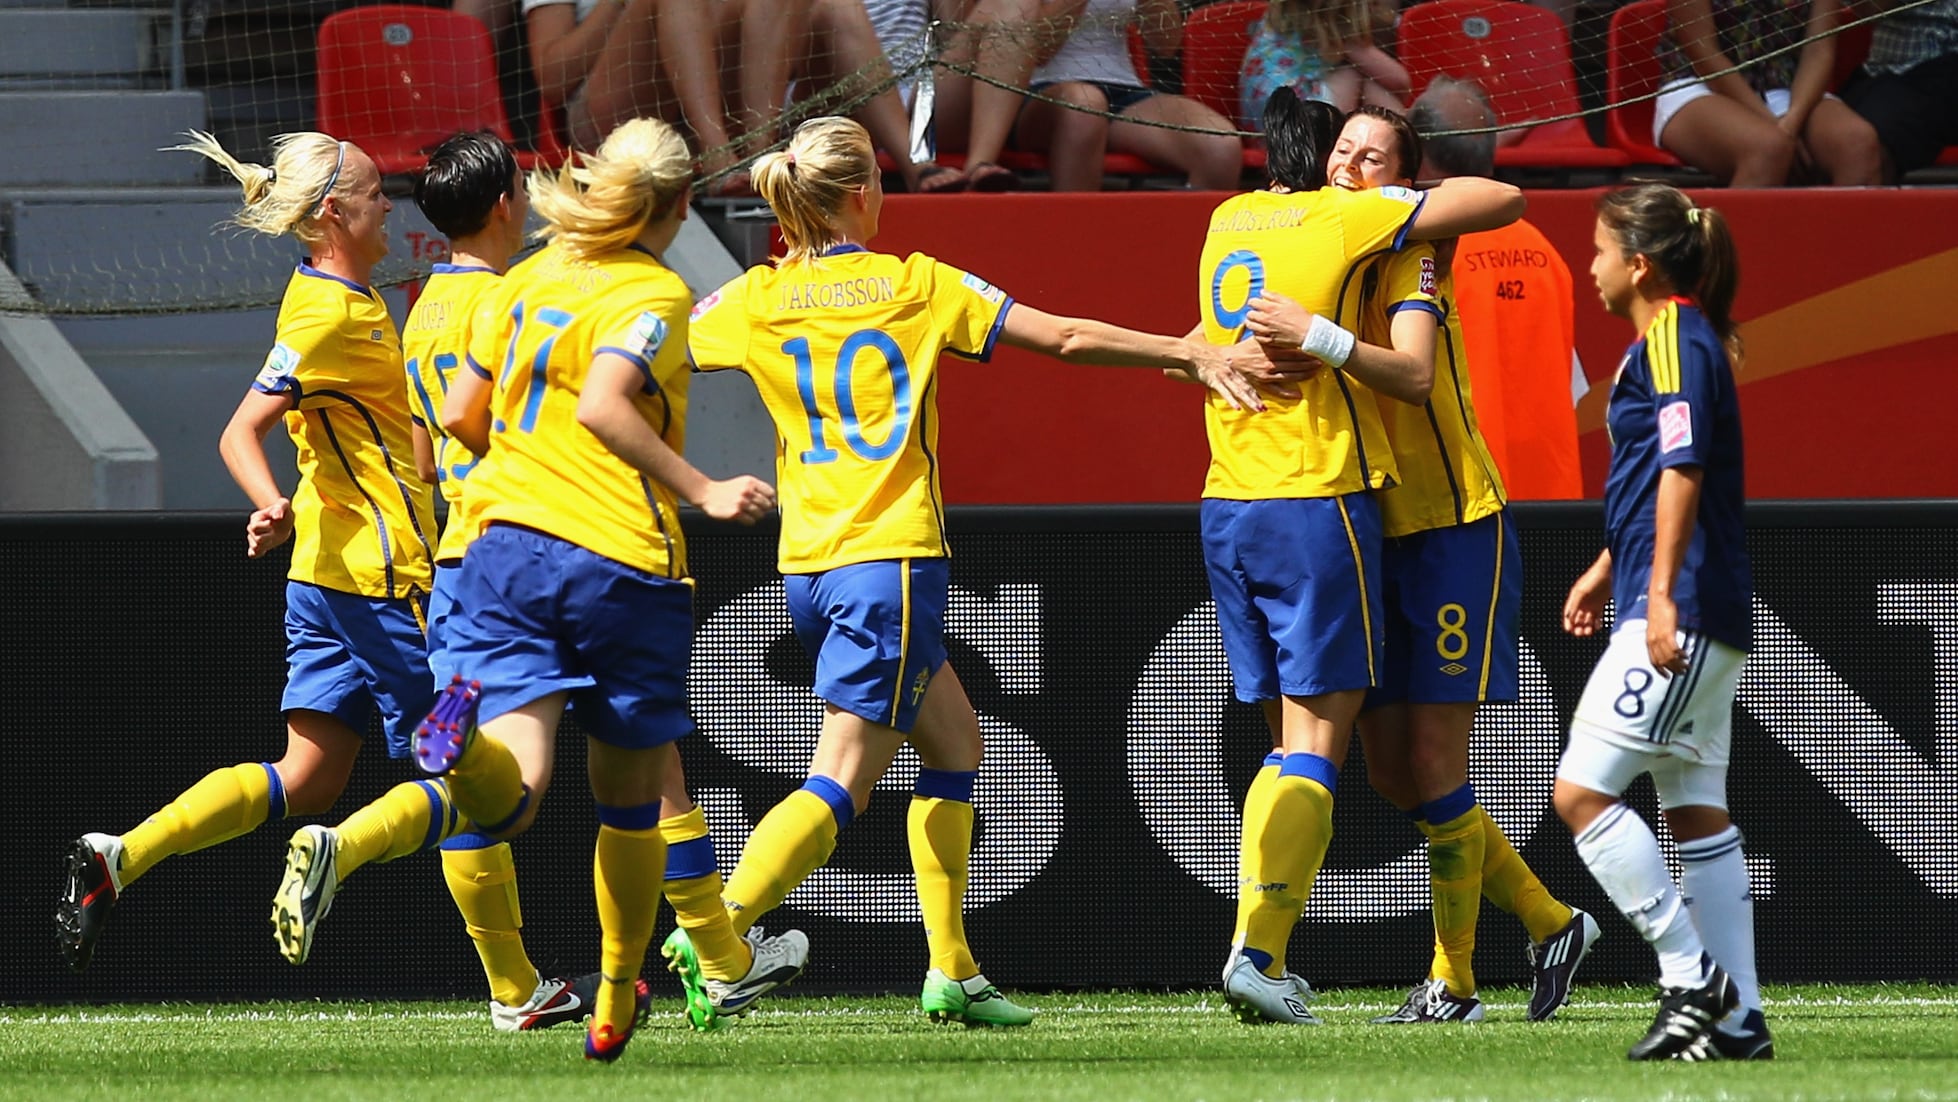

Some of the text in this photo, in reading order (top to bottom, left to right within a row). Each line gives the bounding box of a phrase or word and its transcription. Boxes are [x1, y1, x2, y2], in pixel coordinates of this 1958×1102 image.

[1464, 249, 1548, 272] STEWARD
[778, 277, 894, 310] JAKOBSSON
[1211, 249, 1265, 342] 9
[1496, 280, 1525, 300] 462
[493, 299, 576, 434] 17
[781, 328, 911, 464] 10
[1436, 603, 1469, 661] 8
[1614, 667, 1654, 719] 8
